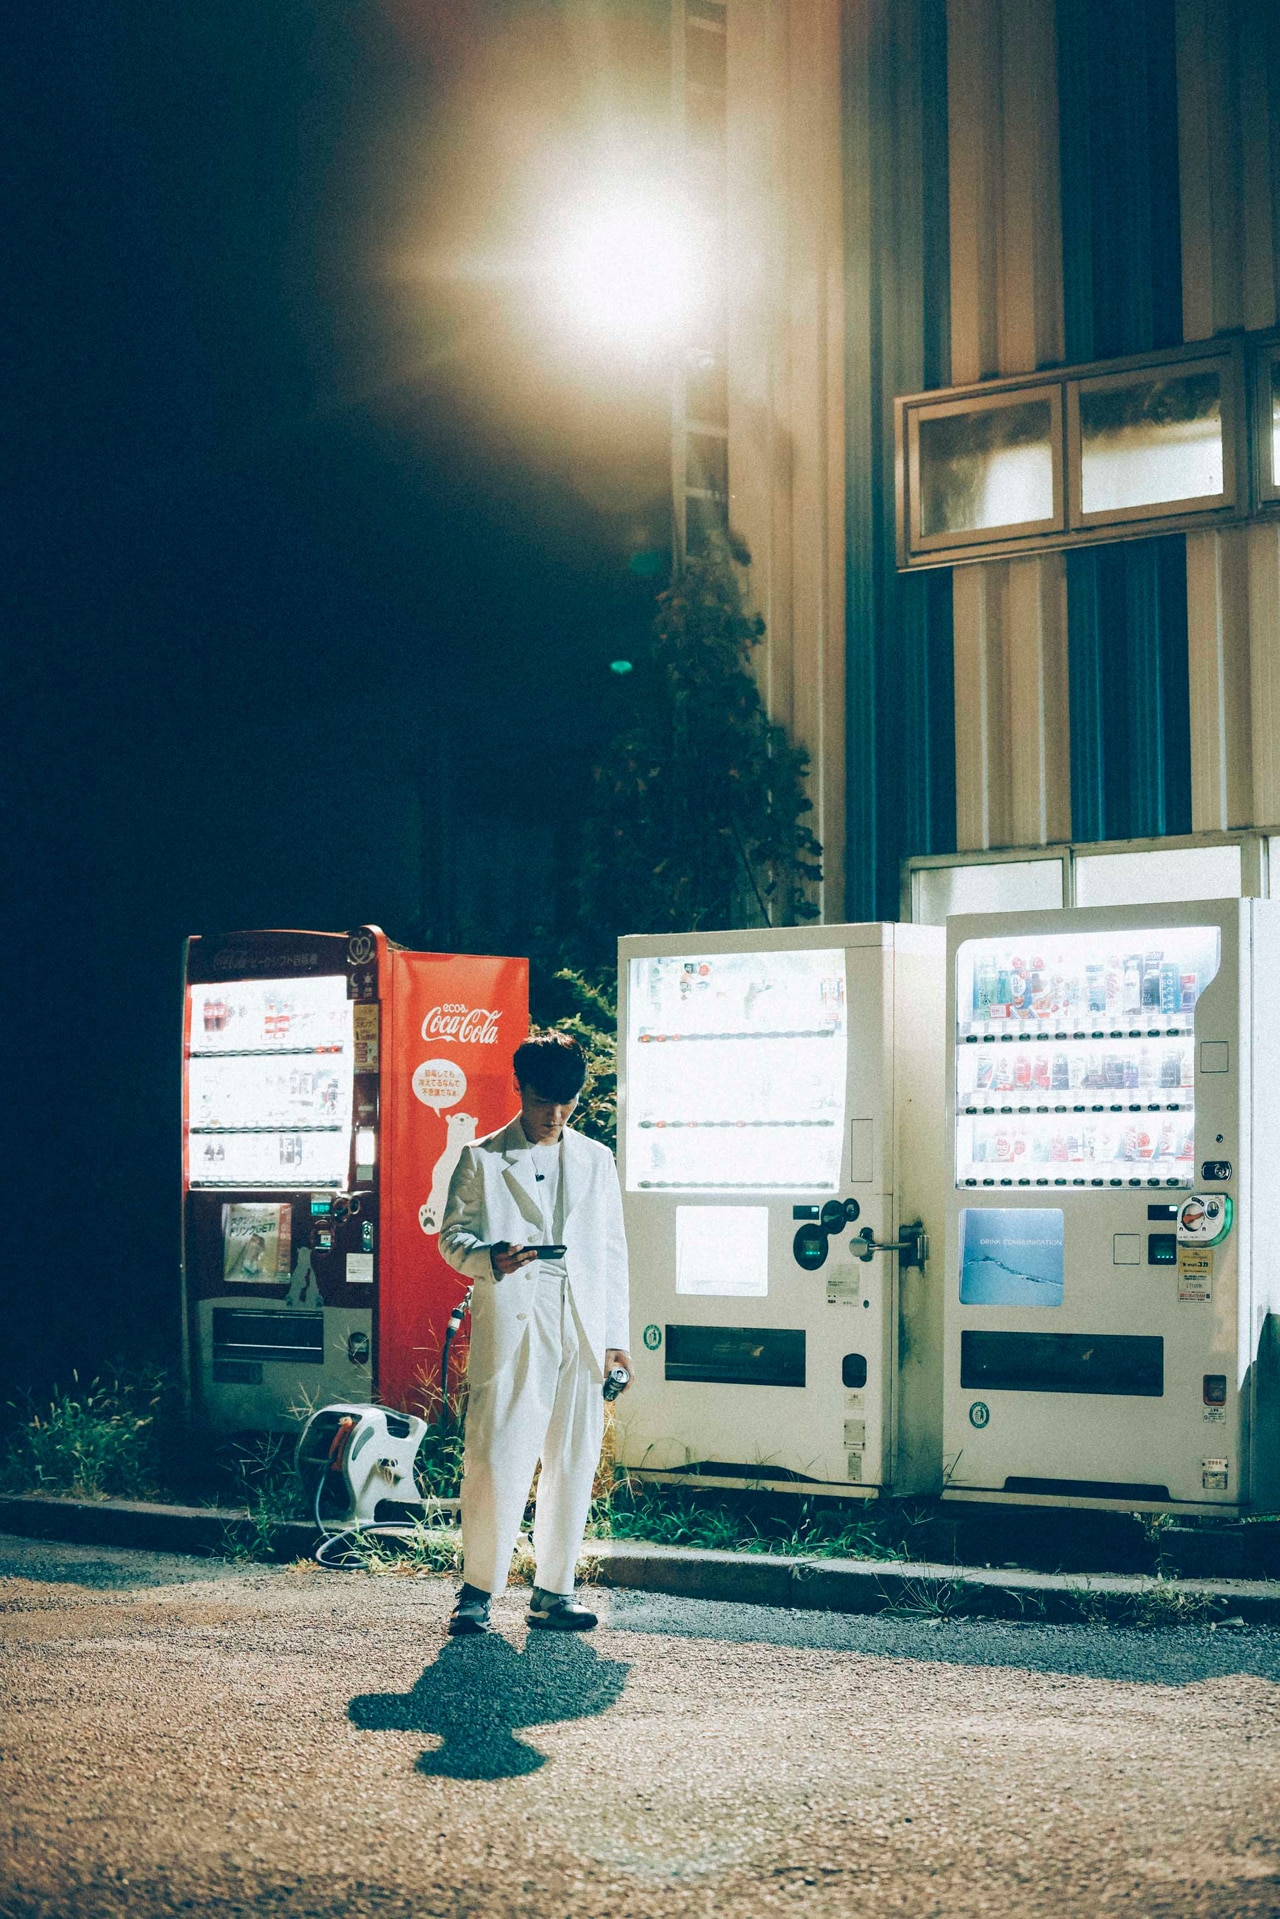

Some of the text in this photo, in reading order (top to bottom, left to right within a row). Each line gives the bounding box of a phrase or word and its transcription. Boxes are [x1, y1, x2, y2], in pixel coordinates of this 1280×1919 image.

[1166, 971, 1174, 1014] POCARI
[421, 1006, 503, 1044] Coca-Cola
[979, 1238, 1063, 1246] DRINK COMMUNICATION
